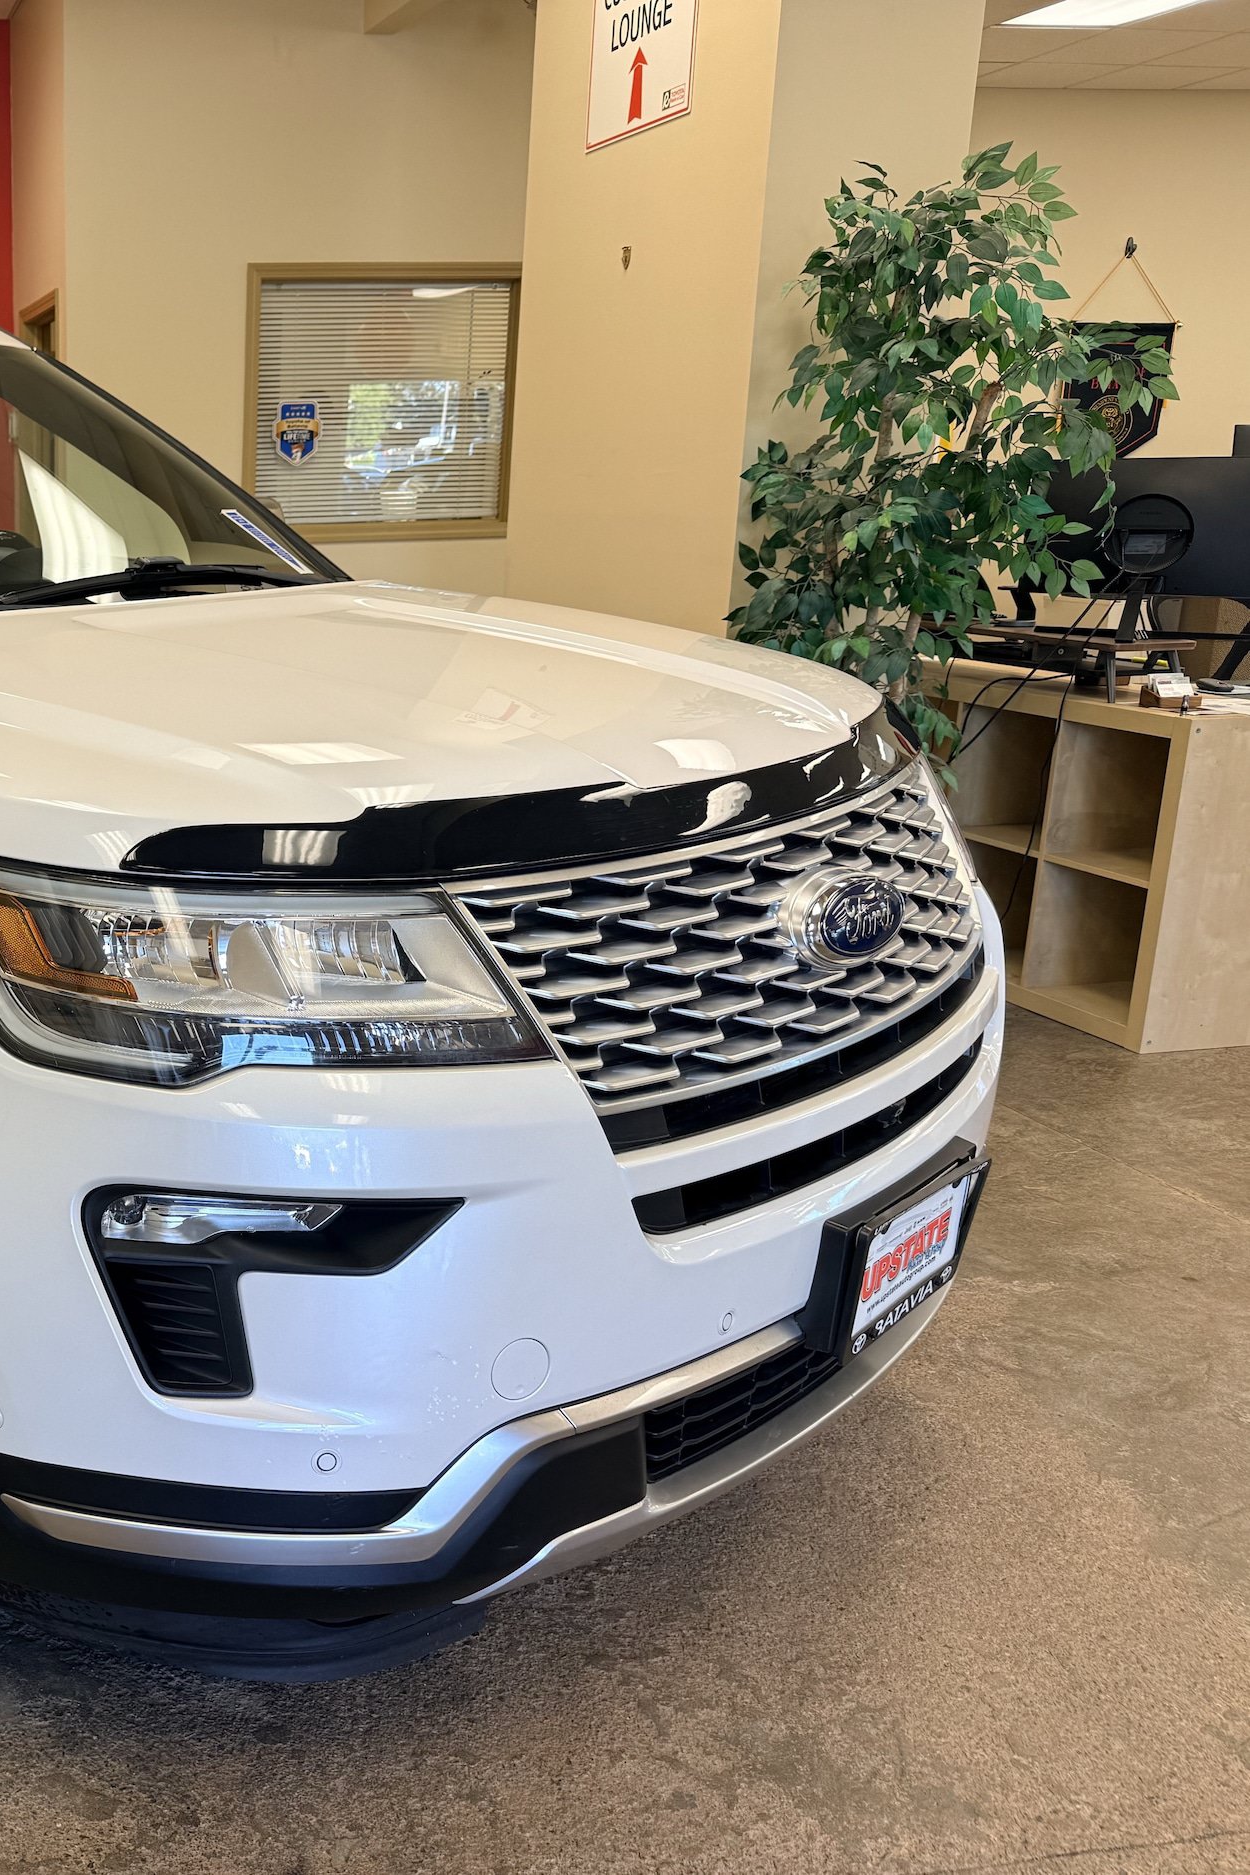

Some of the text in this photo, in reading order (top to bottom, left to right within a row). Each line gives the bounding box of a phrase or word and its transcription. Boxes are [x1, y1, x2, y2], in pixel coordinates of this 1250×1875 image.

[611, 0, 672, 52] LOUNGE
[844, 891, 894, 944] Ford
[861, 1207, 952, 1302] UPSTATE
